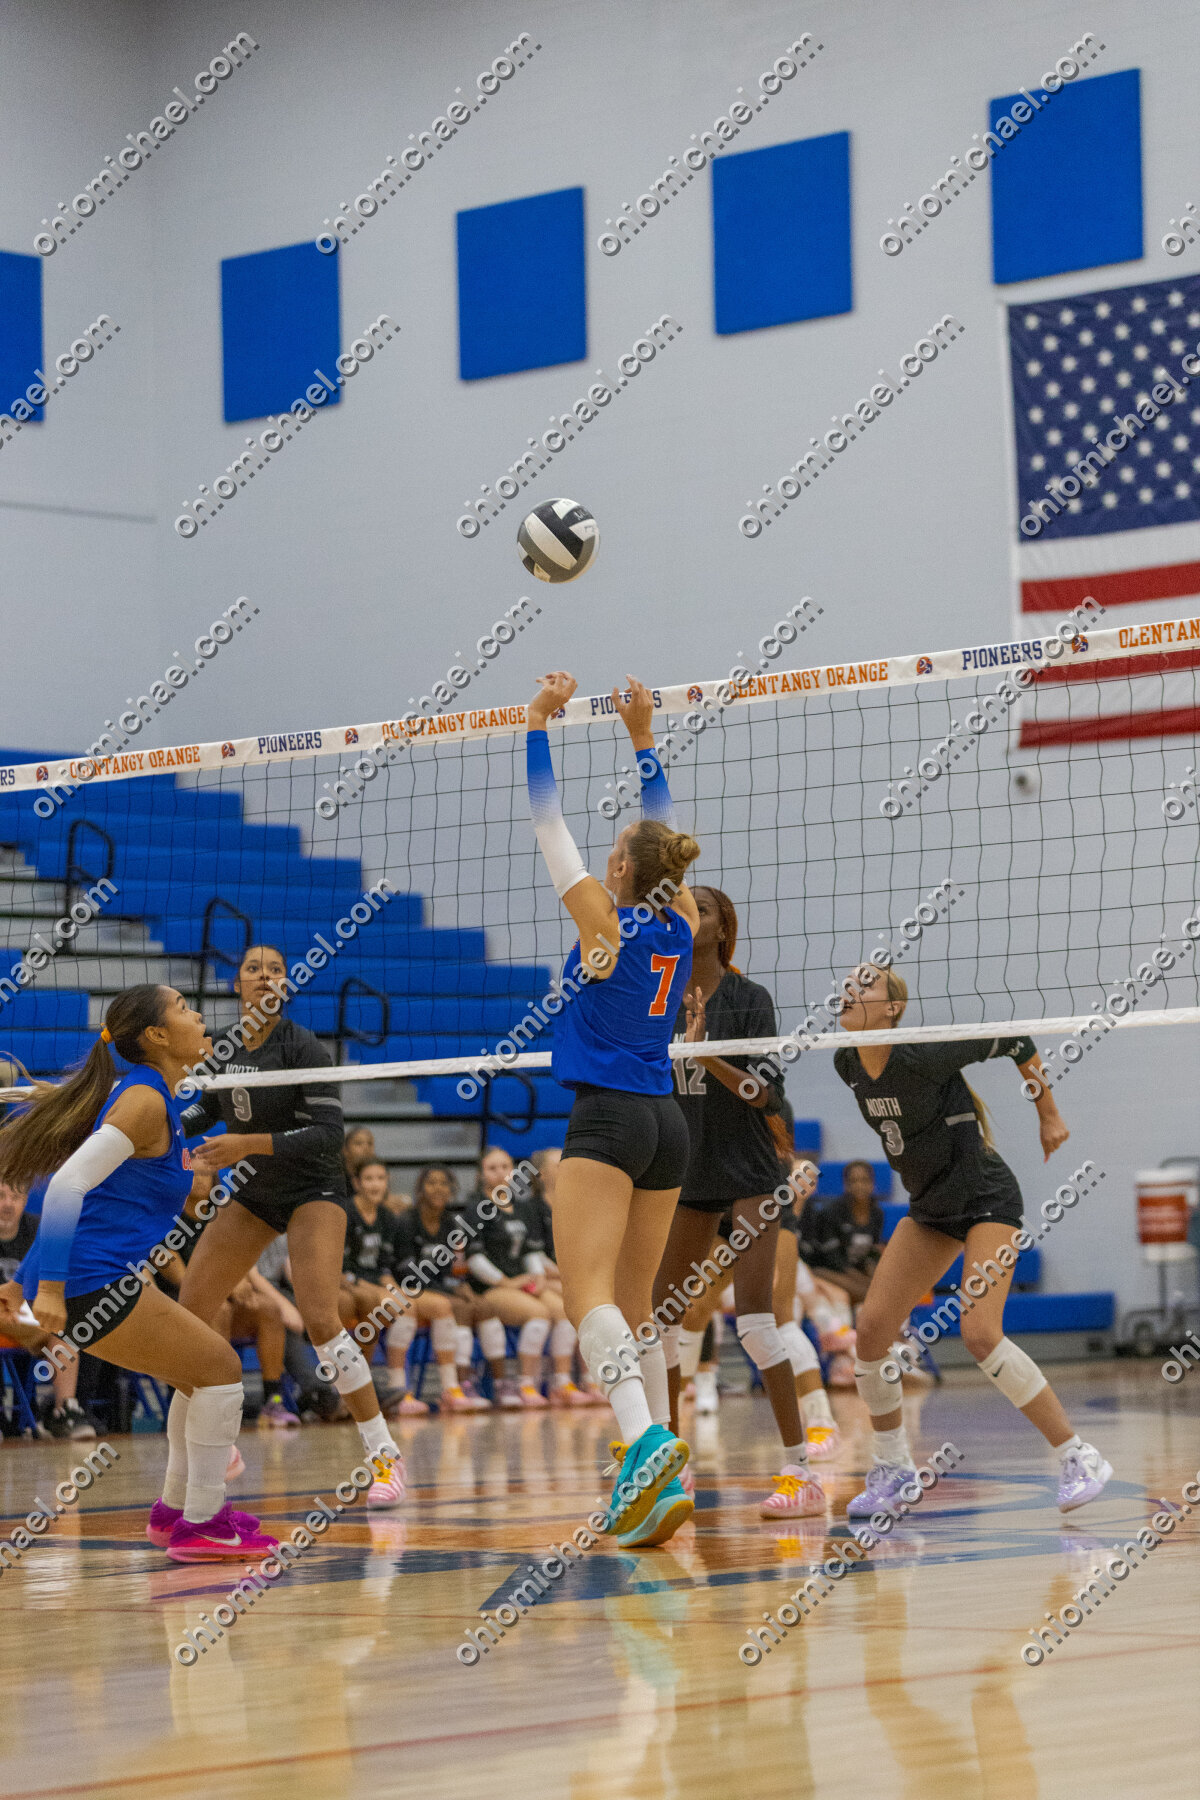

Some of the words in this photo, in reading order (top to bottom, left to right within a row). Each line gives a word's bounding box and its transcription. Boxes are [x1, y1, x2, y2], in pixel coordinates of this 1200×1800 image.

[70, 753, 144, 779] ONTANGY
[149, 746, 201, 768] ORANGE
[257, 731, 322, 754] PIONEERS
[470, 706, 526, 729] ORANGE
[590, 690, 663, 716] PIOES
[728, 669, 821, 699] OLENTANGY
[827, 662, 888, 687] ORANGE
[962, 640, 1043, 670] PIONEERS
[648, 953, 680, 1016] 7
[672, 1057, 707, 1095] 12
[231, 1086, 253, 1122] 9
[865, 1097, 902, 1117] NORTH
[880, 1120, 904, 1156] 3
